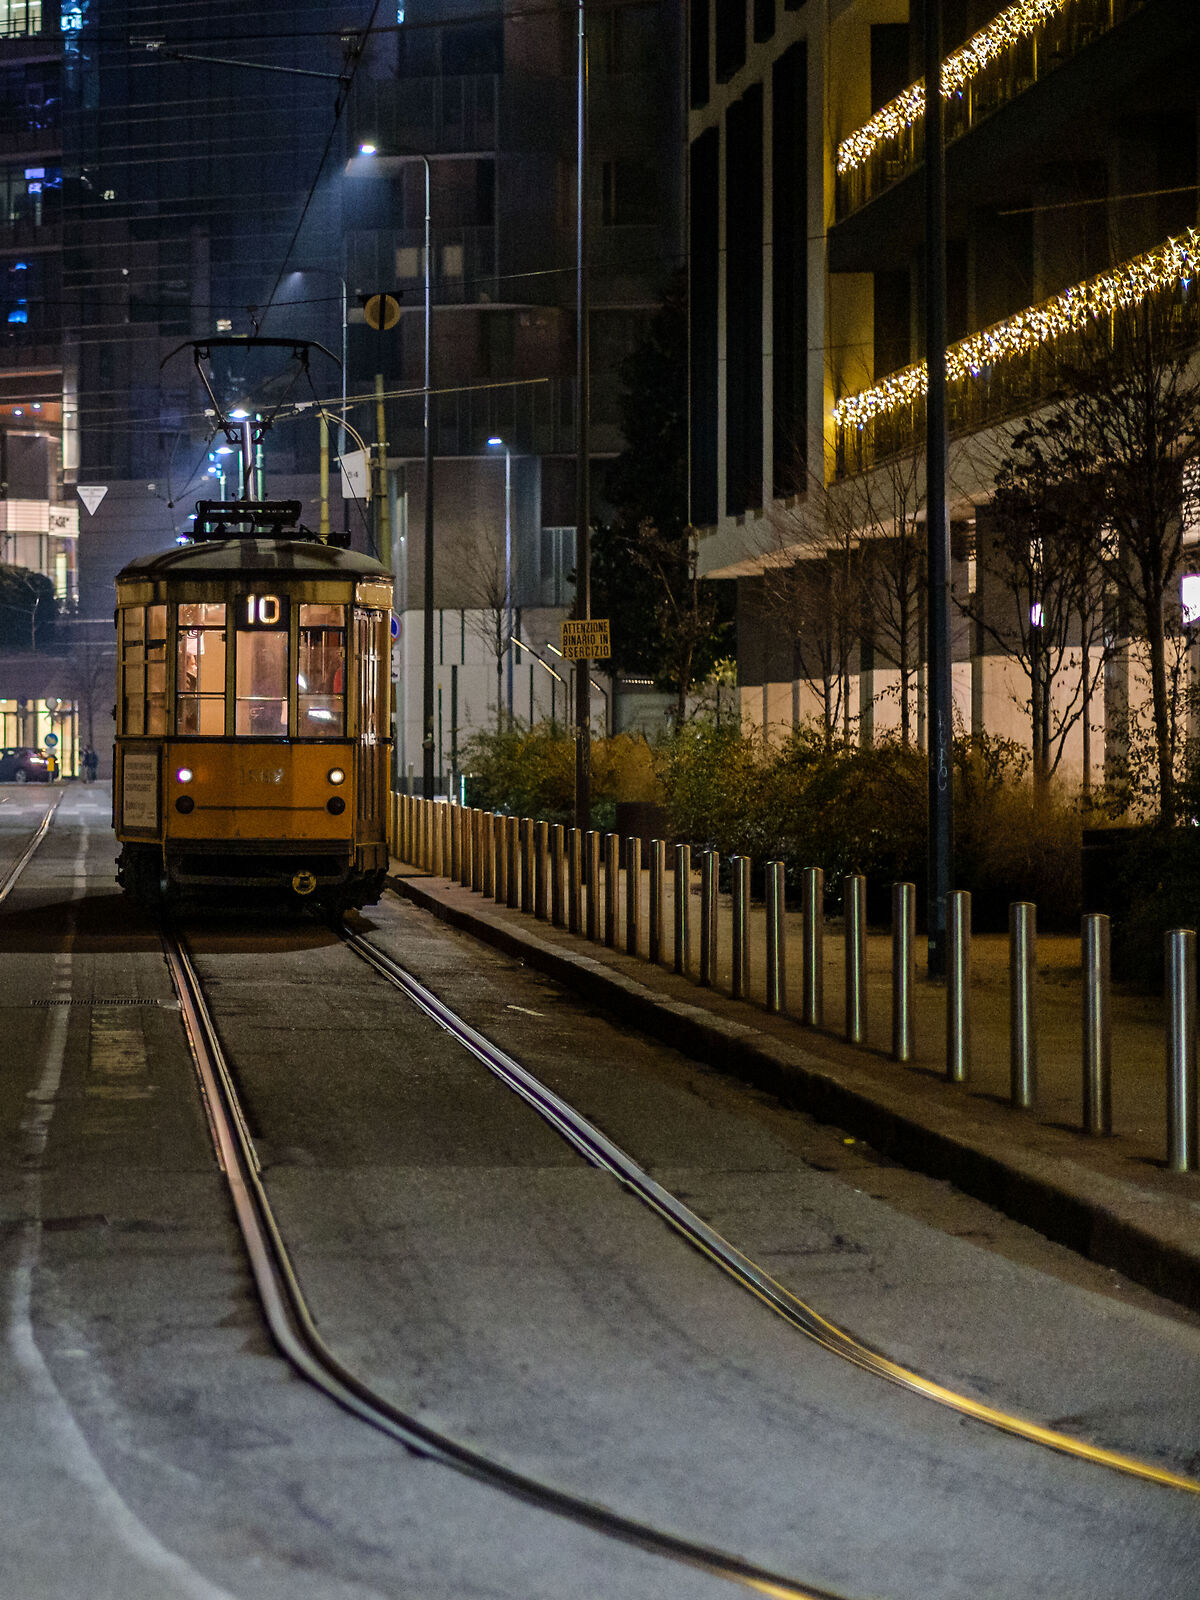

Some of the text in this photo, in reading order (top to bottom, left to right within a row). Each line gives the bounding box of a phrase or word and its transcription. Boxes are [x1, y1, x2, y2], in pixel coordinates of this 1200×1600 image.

[246, 593, 281, 625] 10
[563, 622, 608, 634] ATTENZIONE
[563, 633, 609, 646] BINARIO IN
[563, 645, 609, 658] ESERCIZIO
